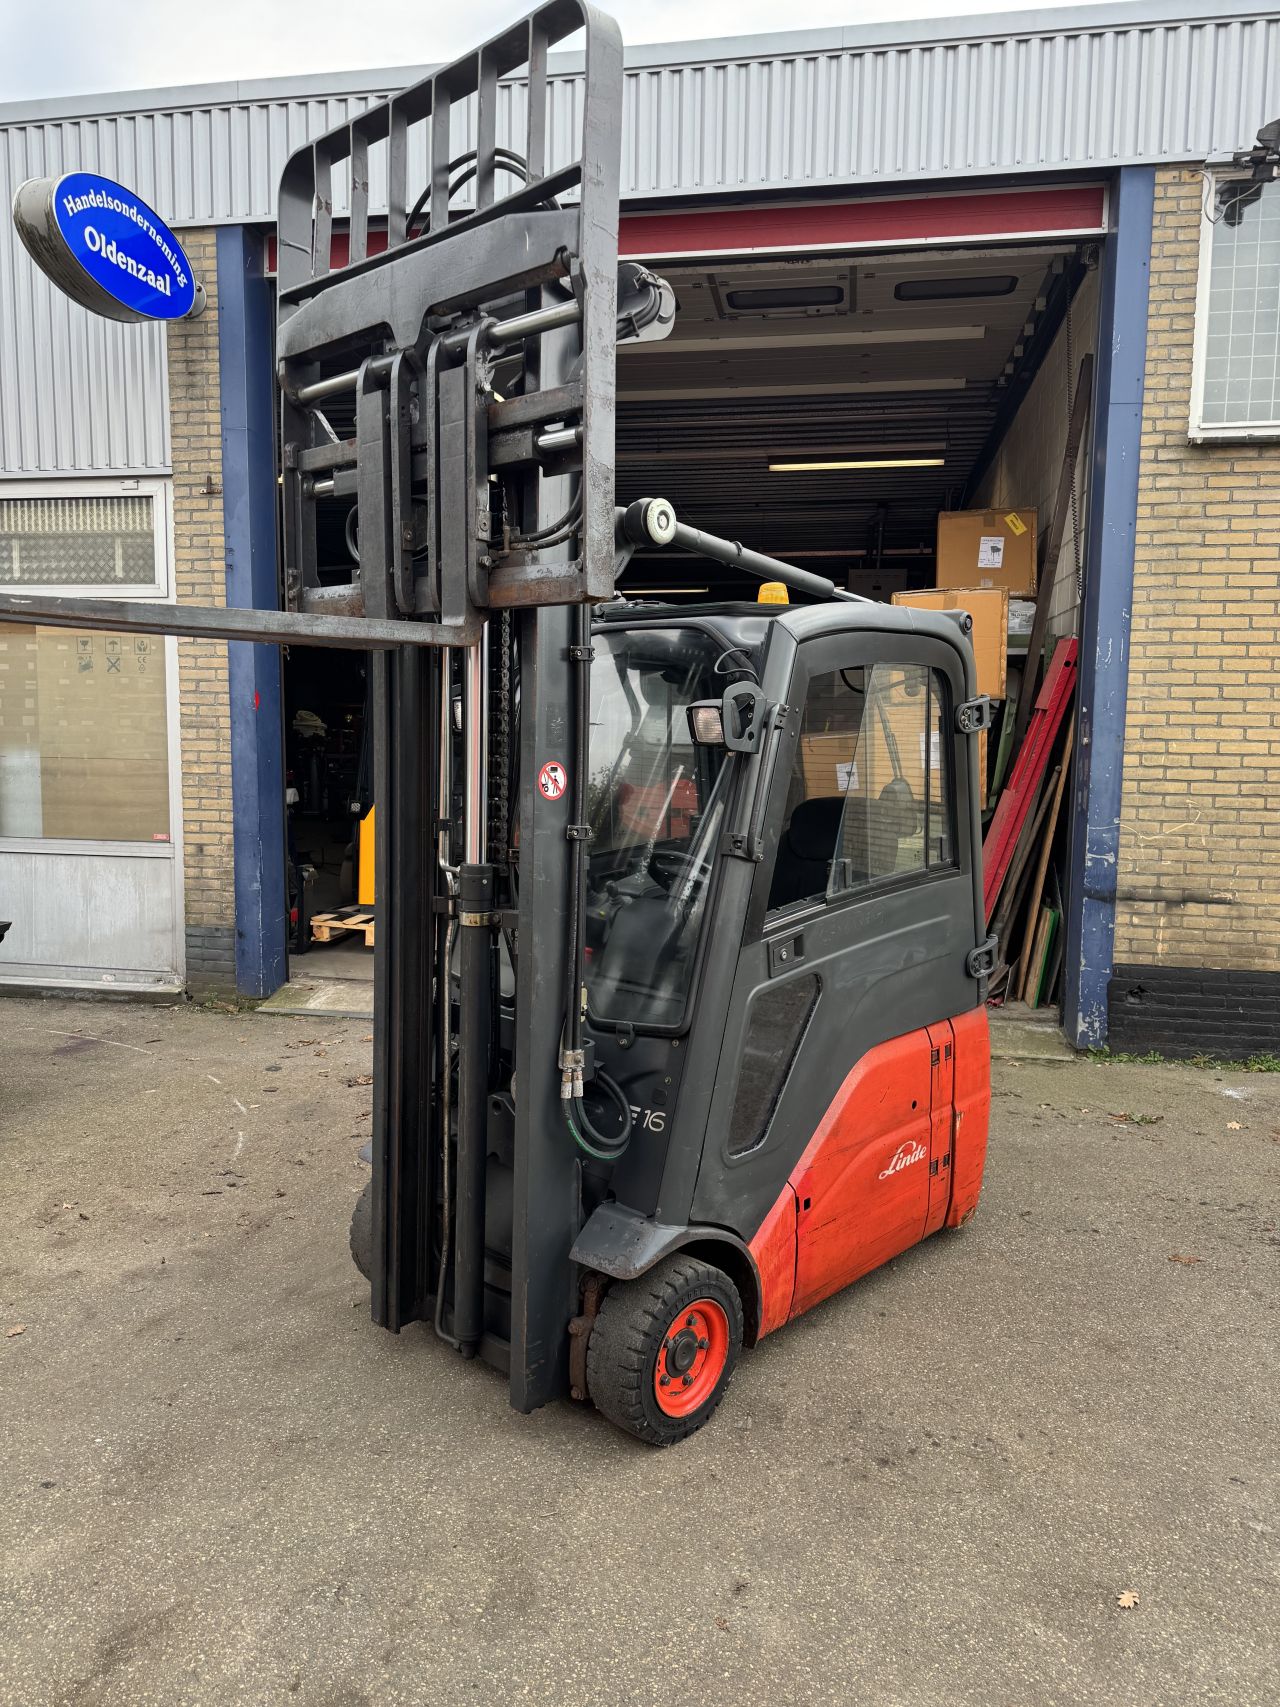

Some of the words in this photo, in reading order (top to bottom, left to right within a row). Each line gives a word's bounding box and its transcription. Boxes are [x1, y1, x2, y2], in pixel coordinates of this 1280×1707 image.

[63, 189, 188, 288] Handelsonderneming
[84, 225, 171, 297] Oldenzaal
[878, 1140, 927, 1180] Linde
